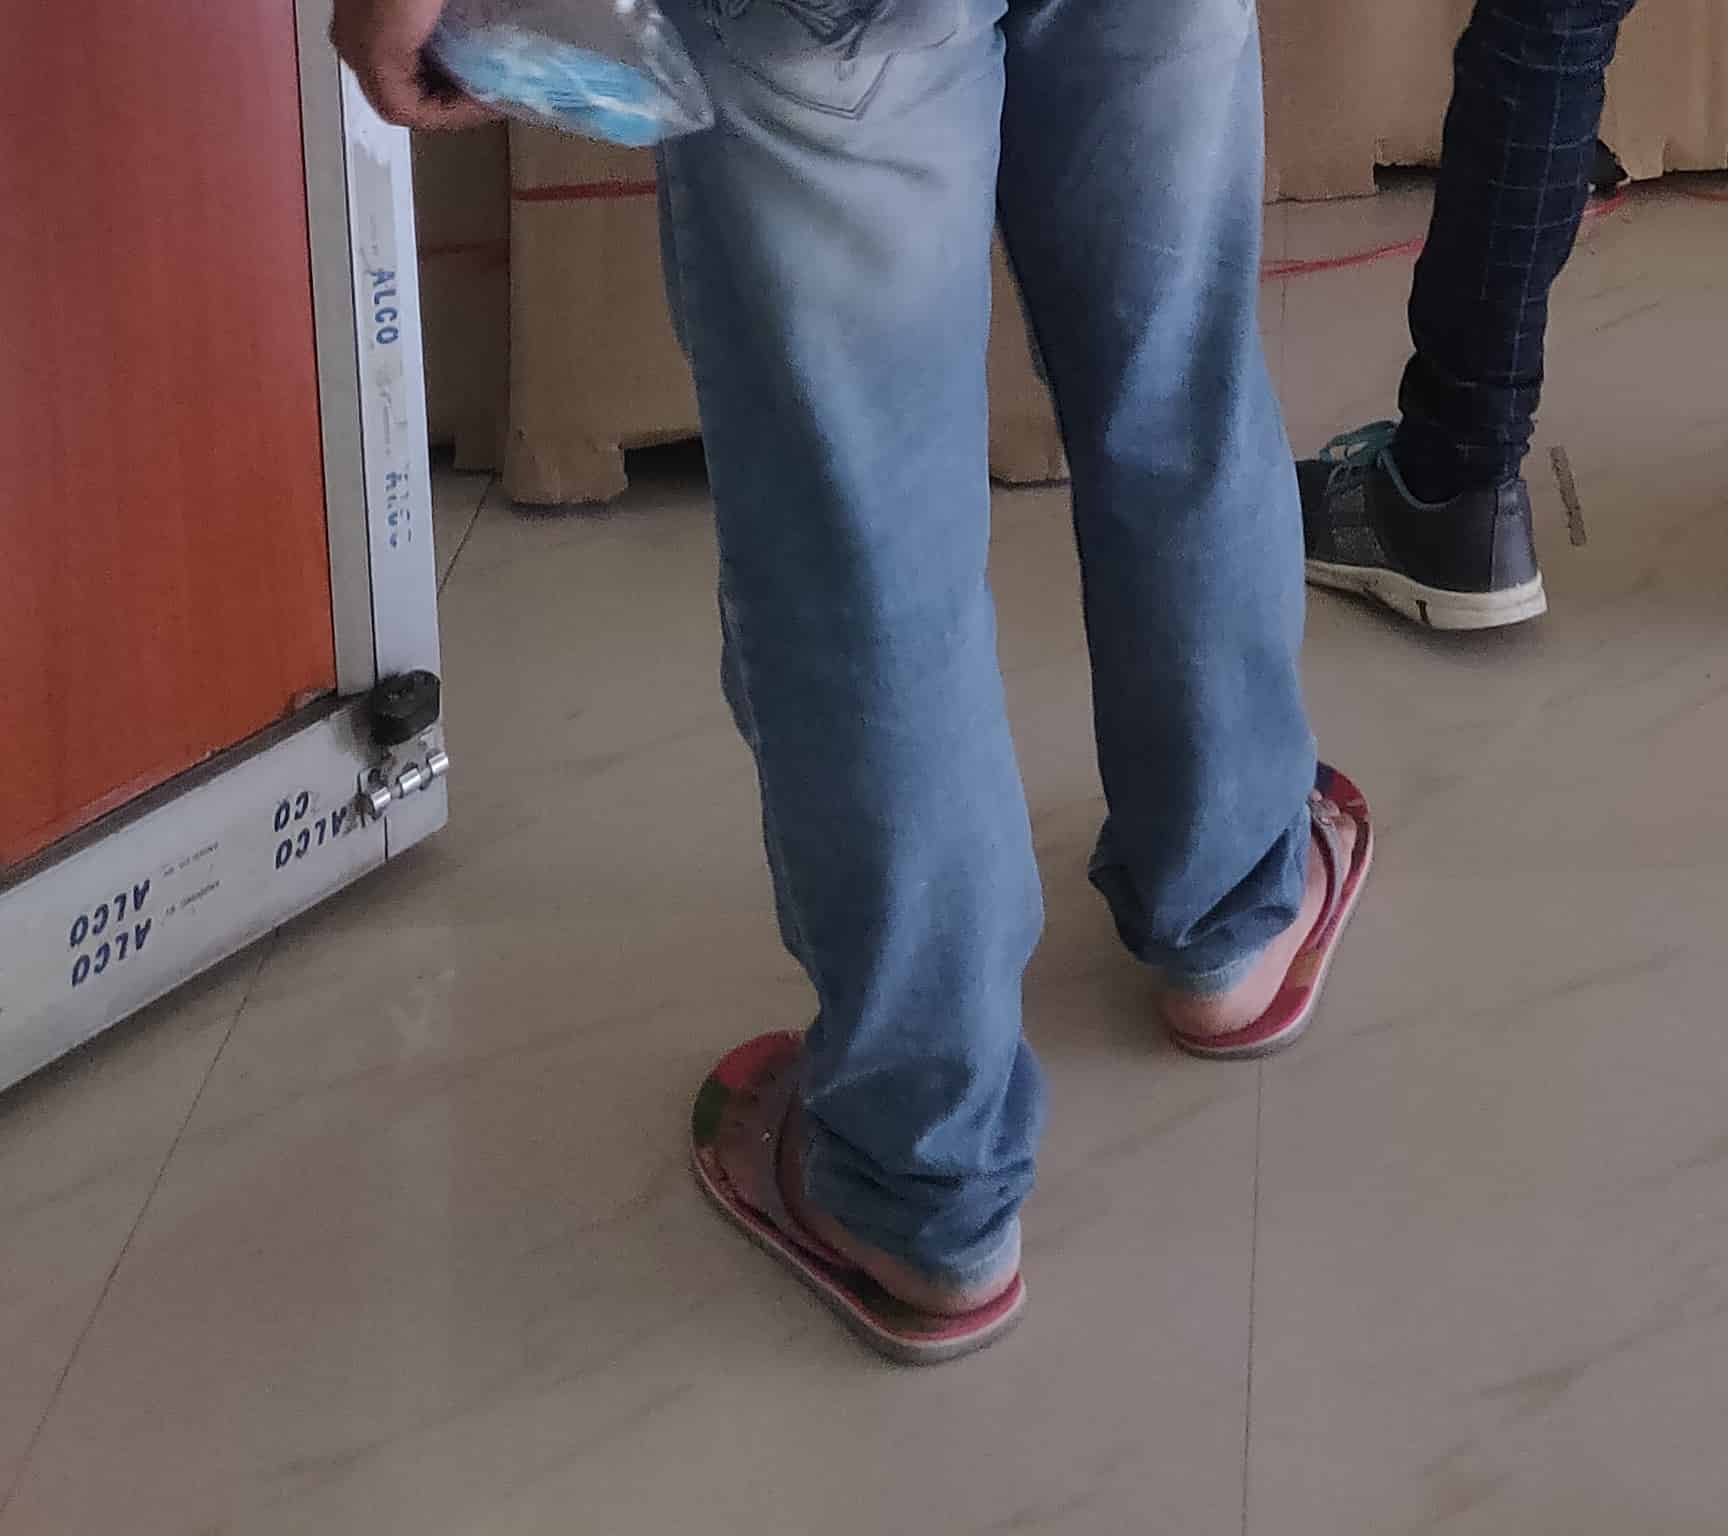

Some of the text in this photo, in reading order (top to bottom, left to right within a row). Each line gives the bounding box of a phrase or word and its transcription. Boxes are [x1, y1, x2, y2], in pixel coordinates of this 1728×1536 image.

[369, 270, 399, 345] ALCO
[275, 804, 348, 870] ALCO
[70, 879, 151, 948] ALCO
[71, 917, 152, 988] ALCO
